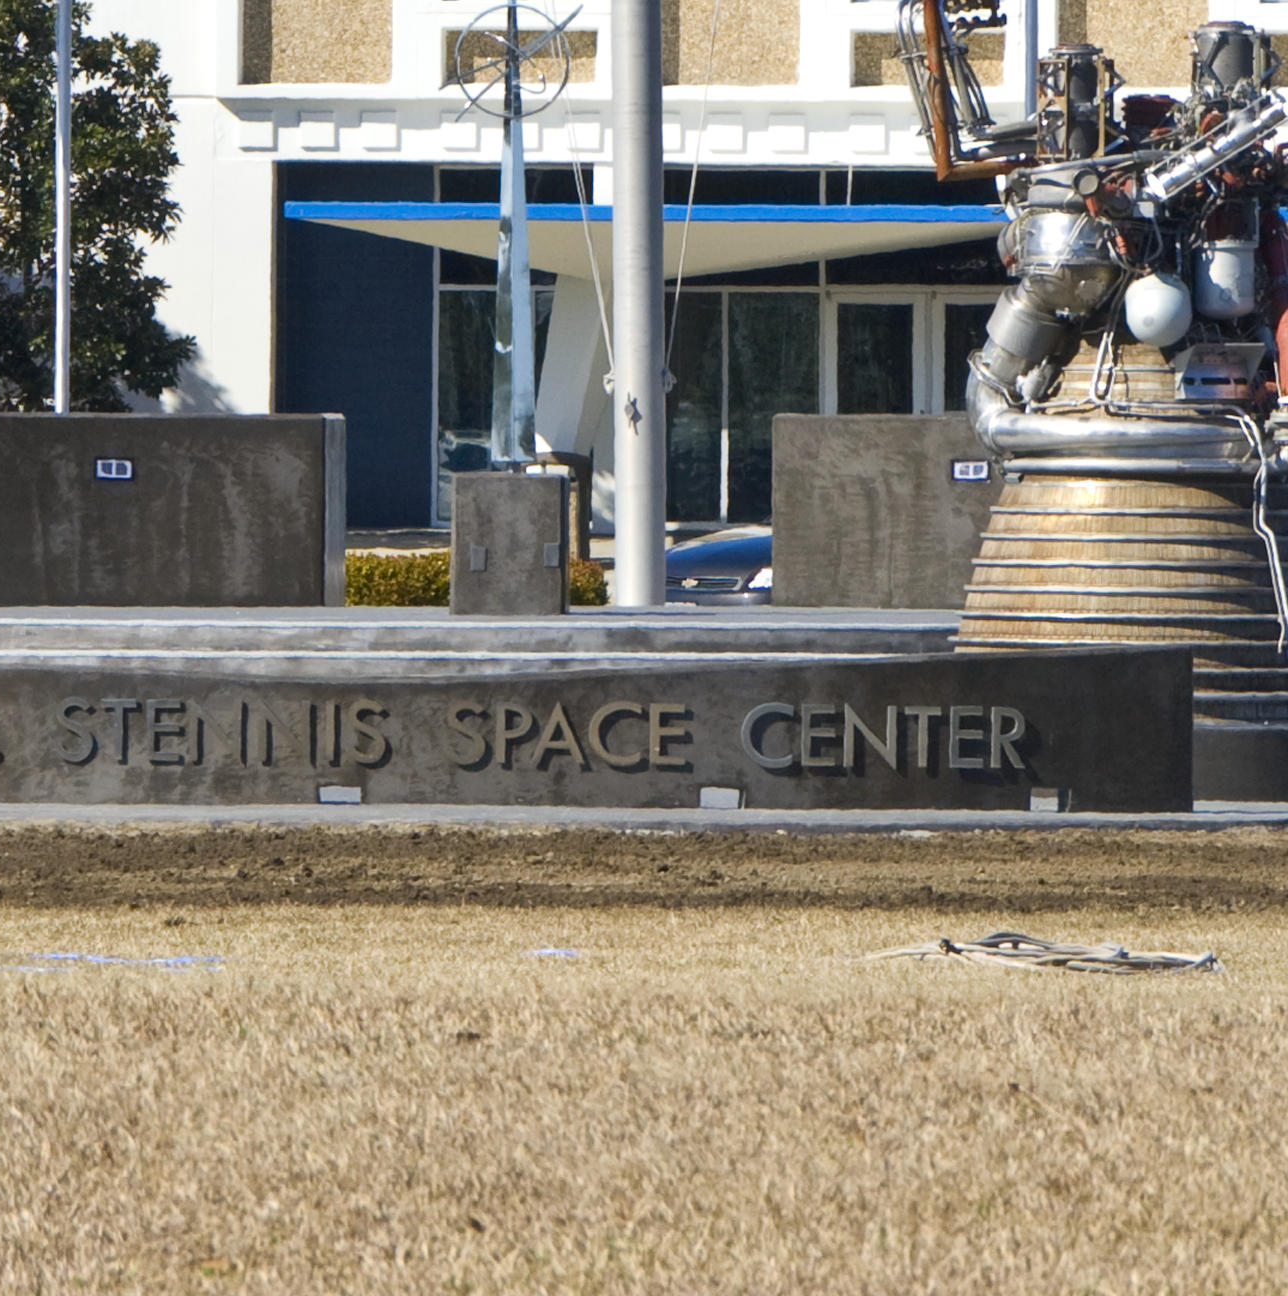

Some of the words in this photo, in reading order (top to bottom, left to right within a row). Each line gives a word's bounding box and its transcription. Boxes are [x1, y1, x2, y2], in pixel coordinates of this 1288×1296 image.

[58, 697, 393, 770] STENNIS
[448, 701, 694, 772] SPACE
[741, 702, 1029, 772] CENTER
